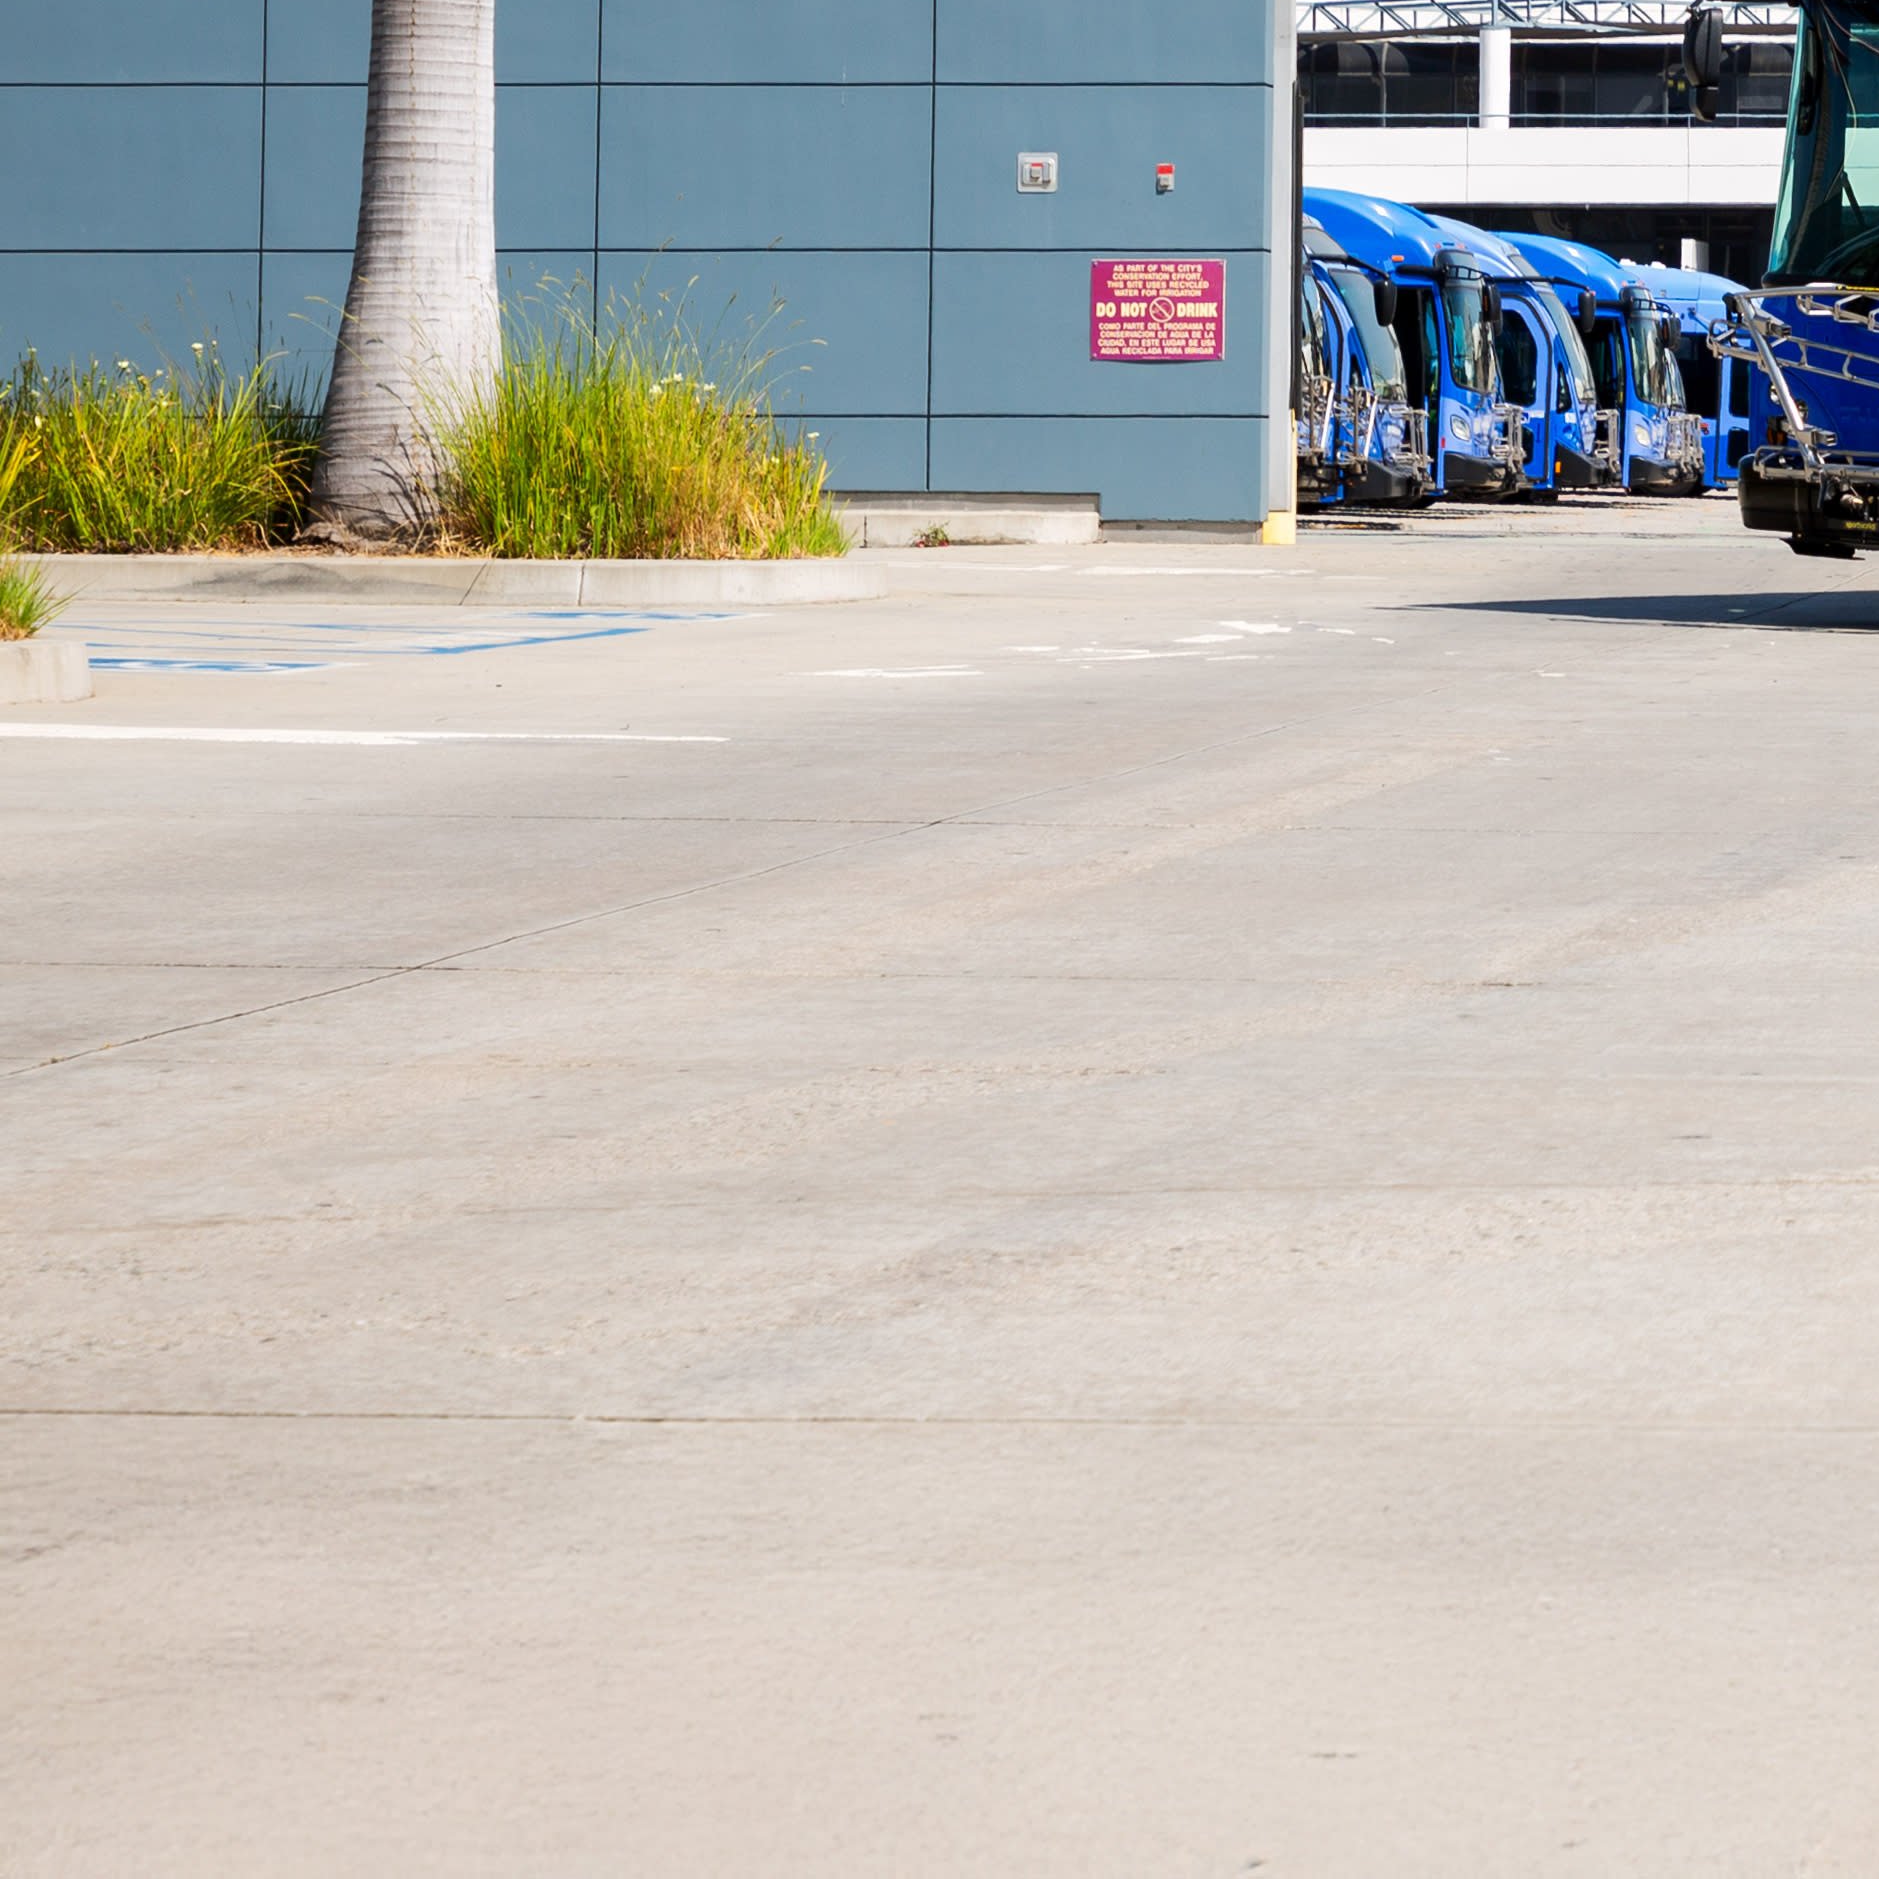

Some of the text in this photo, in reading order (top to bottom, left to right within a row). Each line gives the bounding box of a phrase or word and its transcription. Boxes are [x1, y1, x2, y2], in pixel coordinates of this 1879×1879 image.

[1147, 264, 1158, 272] OF
[1160, 264, 1175, 272] THE
[1169, 280, 1209, 289] RECYCLED
[1114, 289, 1139, 297] WATER
[1141, 289, 1157, 297] FOR
[1096, 302, 1218, 318] DO NOT DRINK
[1204, 330, 1214, 338] LA
